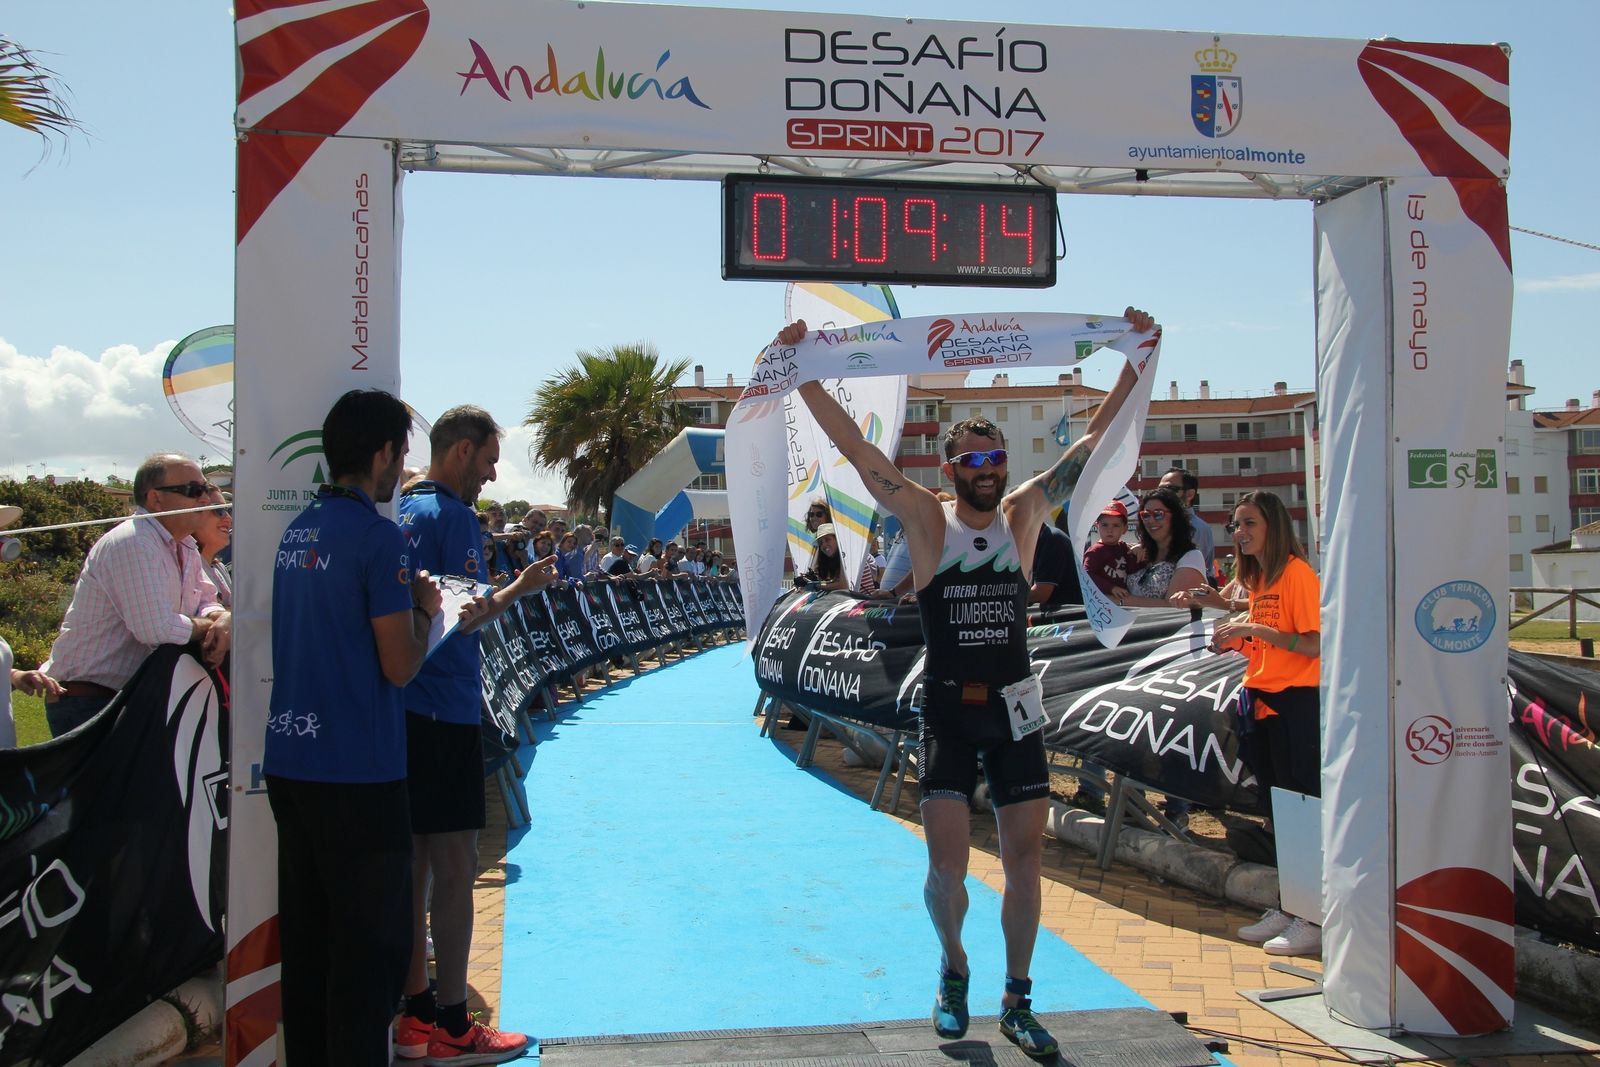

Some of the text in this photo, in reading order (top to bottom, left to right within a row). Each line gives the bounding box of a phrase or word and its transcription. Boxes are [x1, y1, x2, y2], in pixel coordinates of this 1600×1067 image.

[785, 27, 1048, 73] DESAFÍO
[456, 38, 712, 110] Andalucía
[785, 73, 1047, 122] DOÑANA
[790, 122, 1045, 157] SPRINT 2017
[1128, 145, 1306, 164] ayuntamientoalmonte
[351, 173, 368, 371] Matalascañas
[1408, 194, 1430, 371] 13 de mayo
[815, 324, 903, 346] Andalucía
[960, 317, 1025, 334] Andalucía
[941, 333, 1029, 348] DESAFÍO
[942, 343, 1032, 359] DOÑANA
[945, 352, 1032, 367] SPRINT 2017
[770, 372, 798, 394] 2017
[267, 489, 298, 500] JUNTA
[282, 527, 320, 544] OFICIAL
[943, 584, 978, 599] UTRERA
[1421, 586, 1448, 610] CLUB
[950, 600, 1015, 624] LUMBRERAS
[959, 627, 1009, 640] mobel
[1432, 632, 1484, 650] ALMONTE
[803, 661, 861, 703] DOÑANA
[1014, 700, 1029, 720] 1
[1079, 700, 1258, 788] DOÑAN
